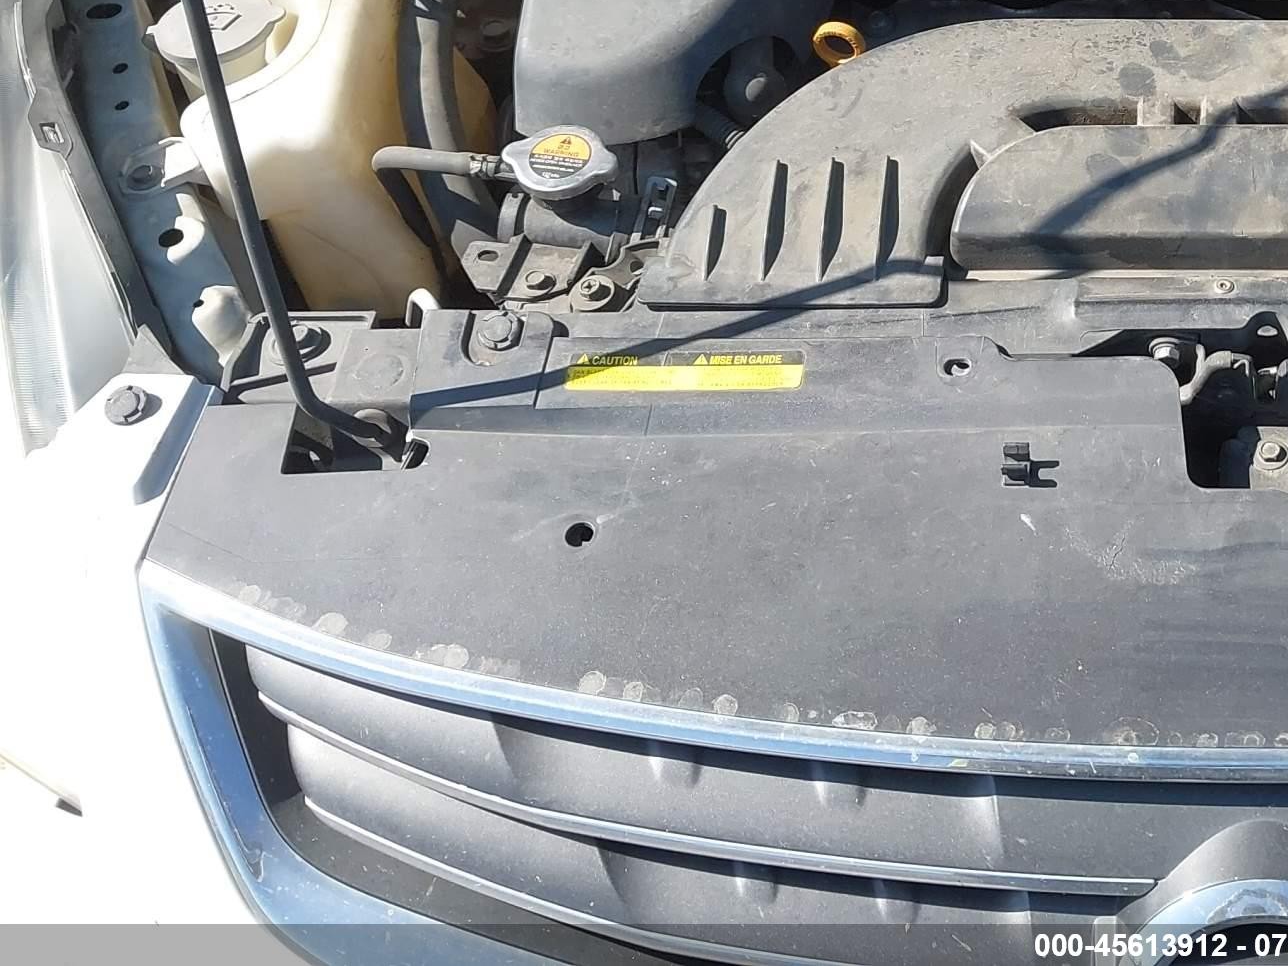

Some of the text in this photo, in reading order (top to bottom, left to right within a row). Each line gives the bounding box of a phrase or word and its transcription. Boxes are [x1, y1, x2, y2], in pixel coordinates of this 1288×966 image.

[544, 148, 579, 157] WARNING
[592, 355, 638, 366] CAUTION
[709, 354, 783, 365] MISE EN GARDE
